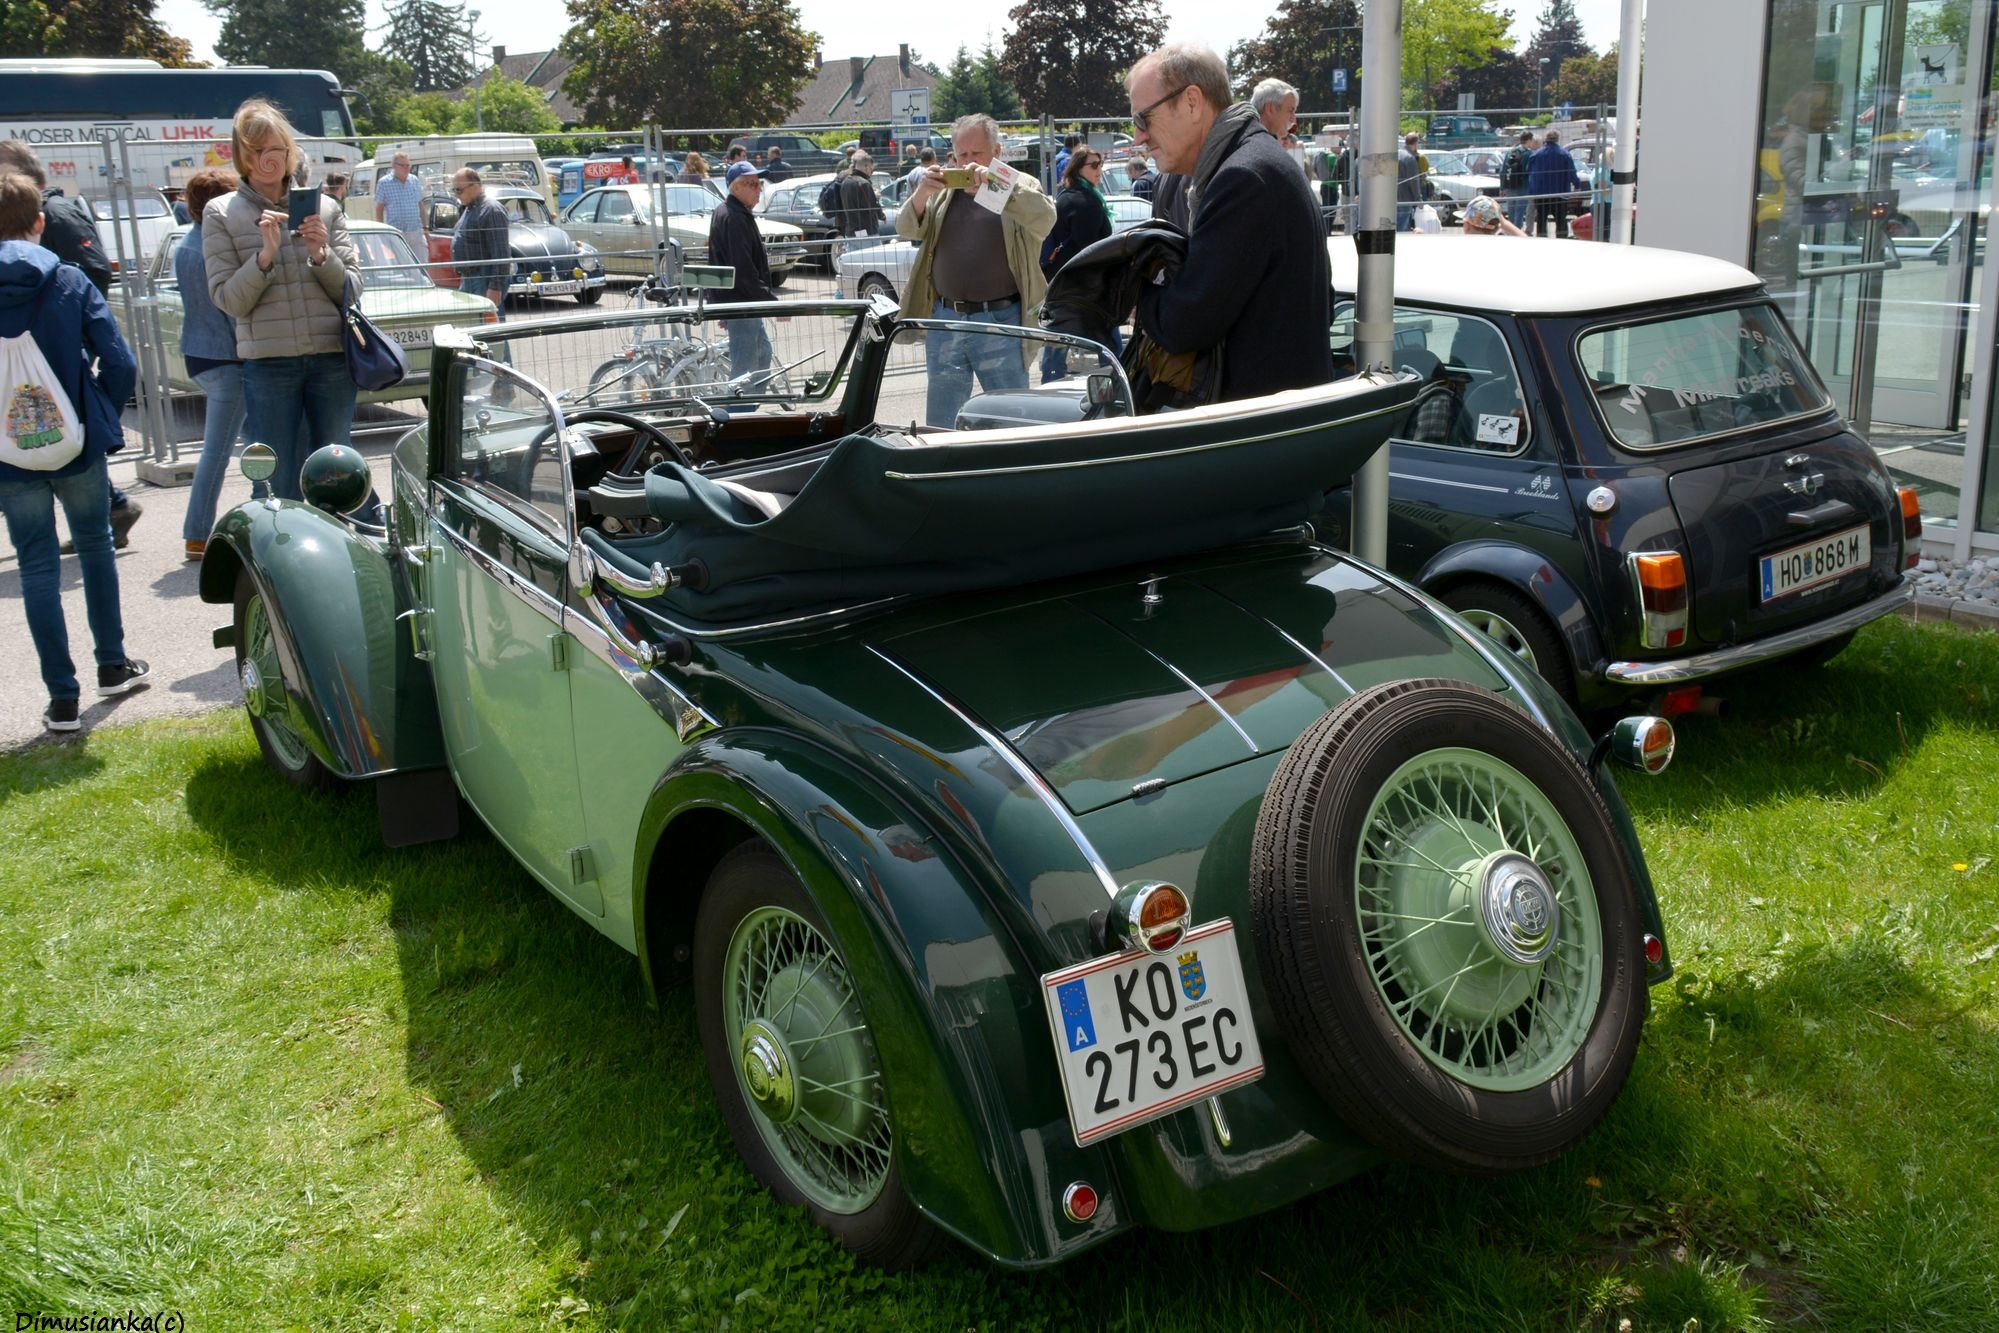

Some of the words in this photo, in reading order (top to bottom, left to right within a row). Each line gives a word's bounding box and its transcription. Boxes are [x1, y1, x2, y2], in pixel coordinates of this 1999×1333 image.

[10, 127, 74, 144] MOSER
[78, 126, 155, 143] MEDICAL
[162, 126, 214, 140] UHK
[1780, 554, 1803, 588] HO
[1815, 540, 1845, 575] 868
[1850, 534, 1859, 564] M
[1114, 962, 1178, 1033] KO
[1075, 1026, 1089, 1046] A
